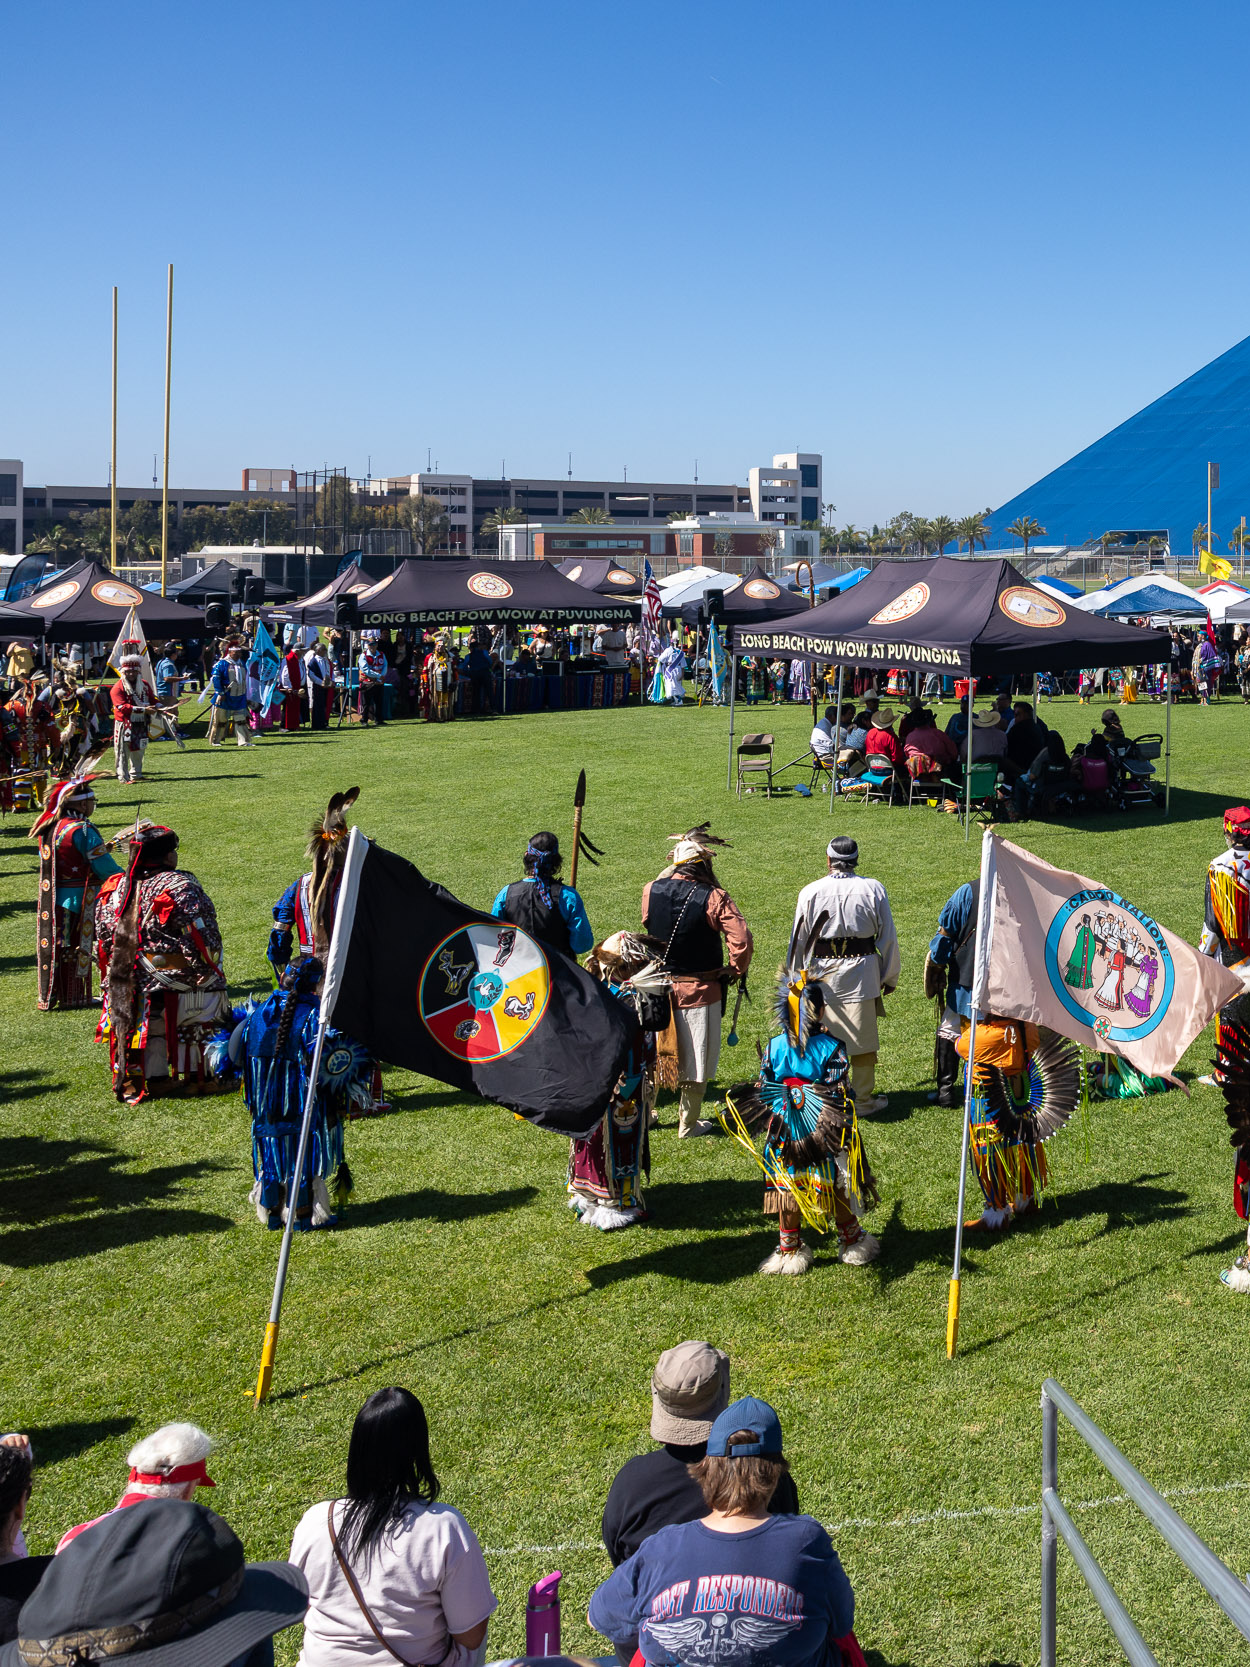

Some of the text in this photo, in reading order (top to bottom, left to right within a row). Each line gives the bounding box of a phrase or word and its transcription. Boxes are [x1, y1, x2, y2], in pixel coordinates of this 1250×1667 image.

[363, 609, 633, 624] LONG BEACH POW WOW AT PUVUNGNA
[740, 633, 962, 666] LONG BEACH POW WOW AT PUVUNGNA
